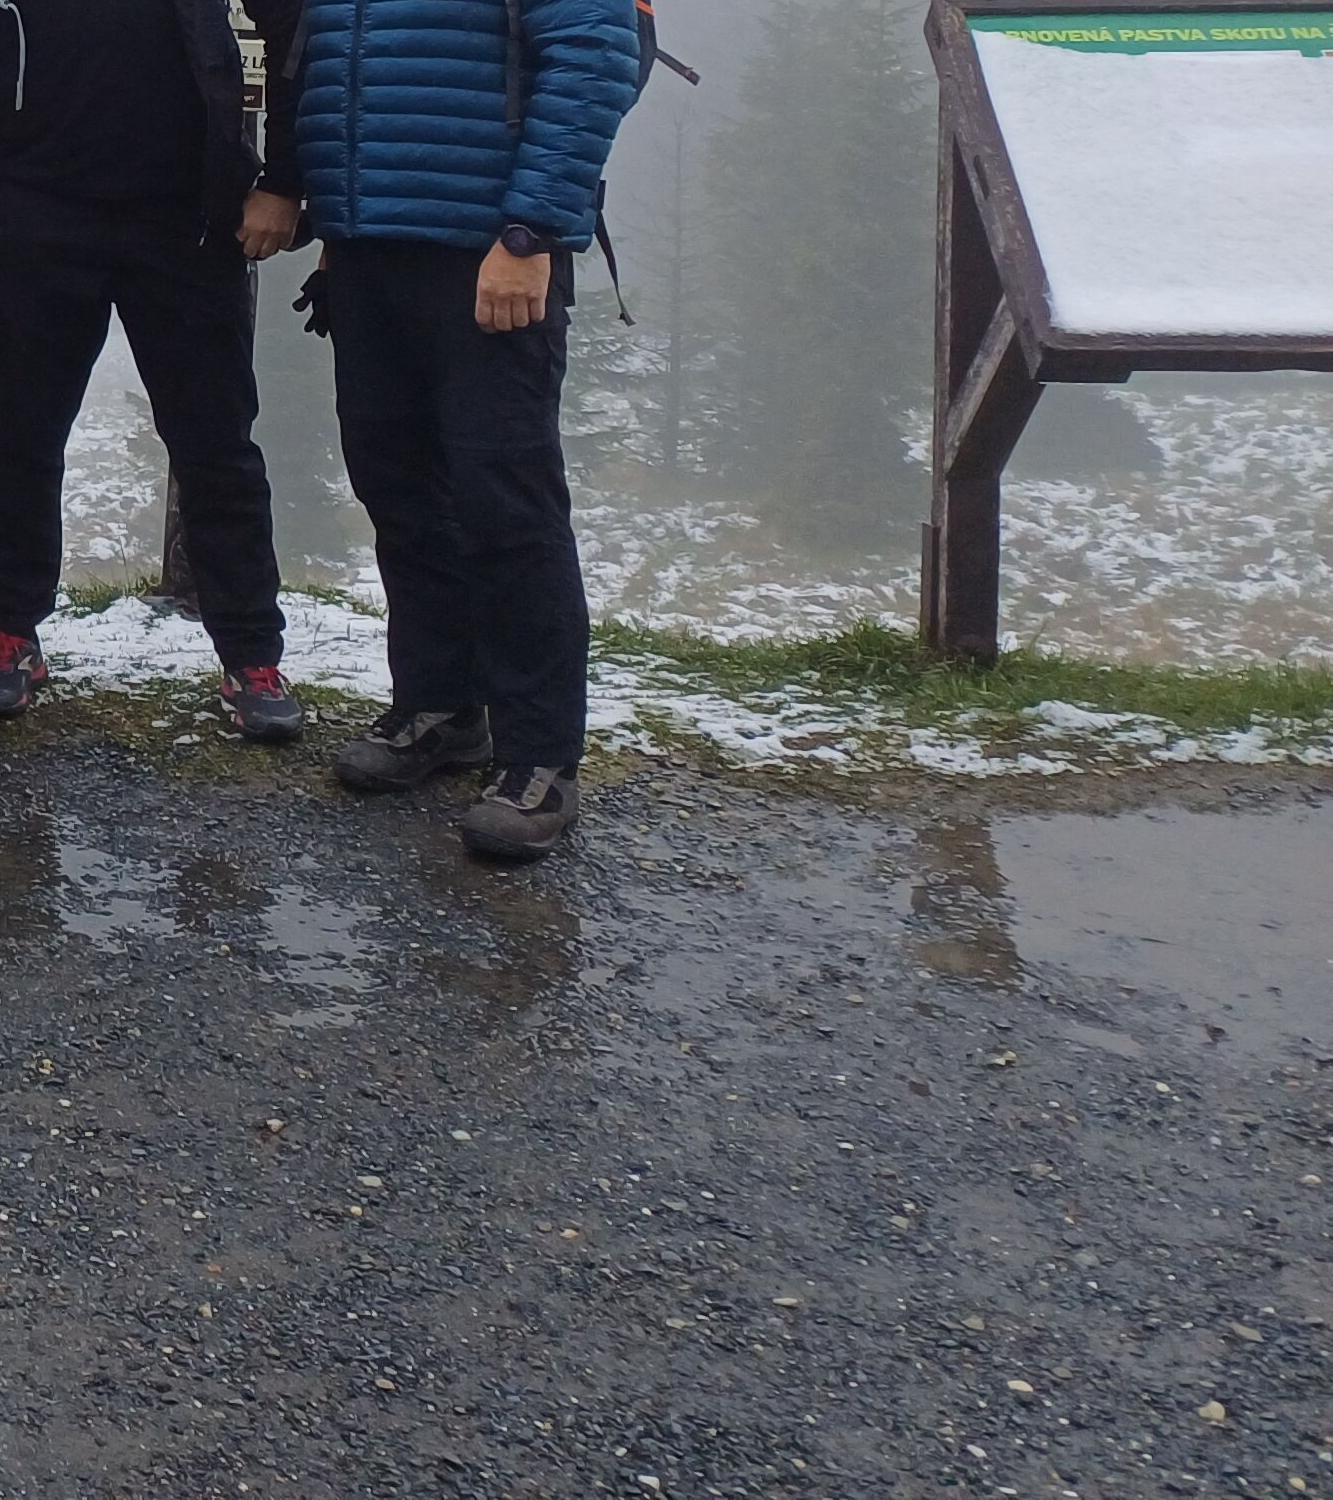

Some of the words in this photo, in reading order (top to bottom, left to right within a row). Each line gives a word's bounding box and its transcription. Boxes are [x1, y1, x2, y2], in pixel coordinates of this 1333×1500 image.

[1004, 26, 1116, 42] NOVENÁ
[1119, 28, 1207, 42] PASTVA
[1209, 27, 1287, 41] SKOTU
[1289, 26, 1327, 39] NA
